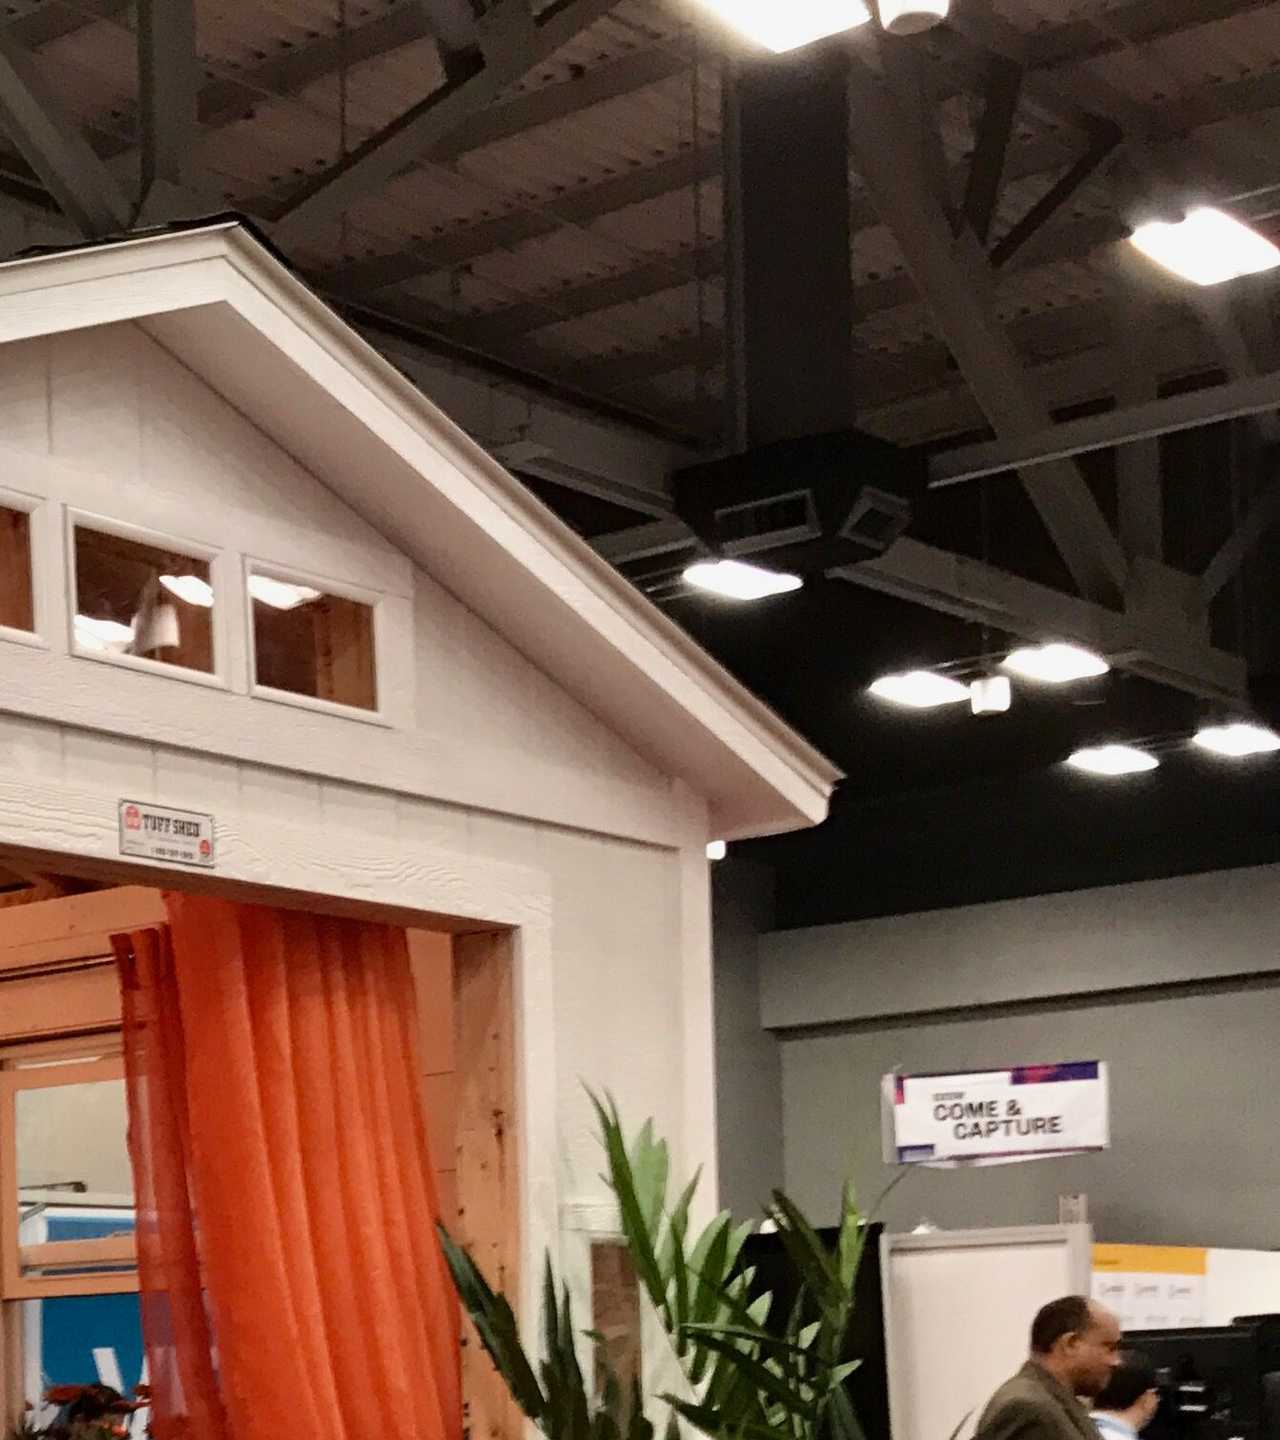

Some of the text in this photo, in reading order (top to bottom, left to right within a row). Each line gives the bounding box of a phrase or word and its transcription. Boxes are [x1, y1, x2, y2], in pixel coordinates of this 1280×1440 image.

[143, 814, 200, 838] TUFF SHED
[933, 1099, 1021, 1121] COME &
[953, 1116, 1063, 1140] CAPTURE
